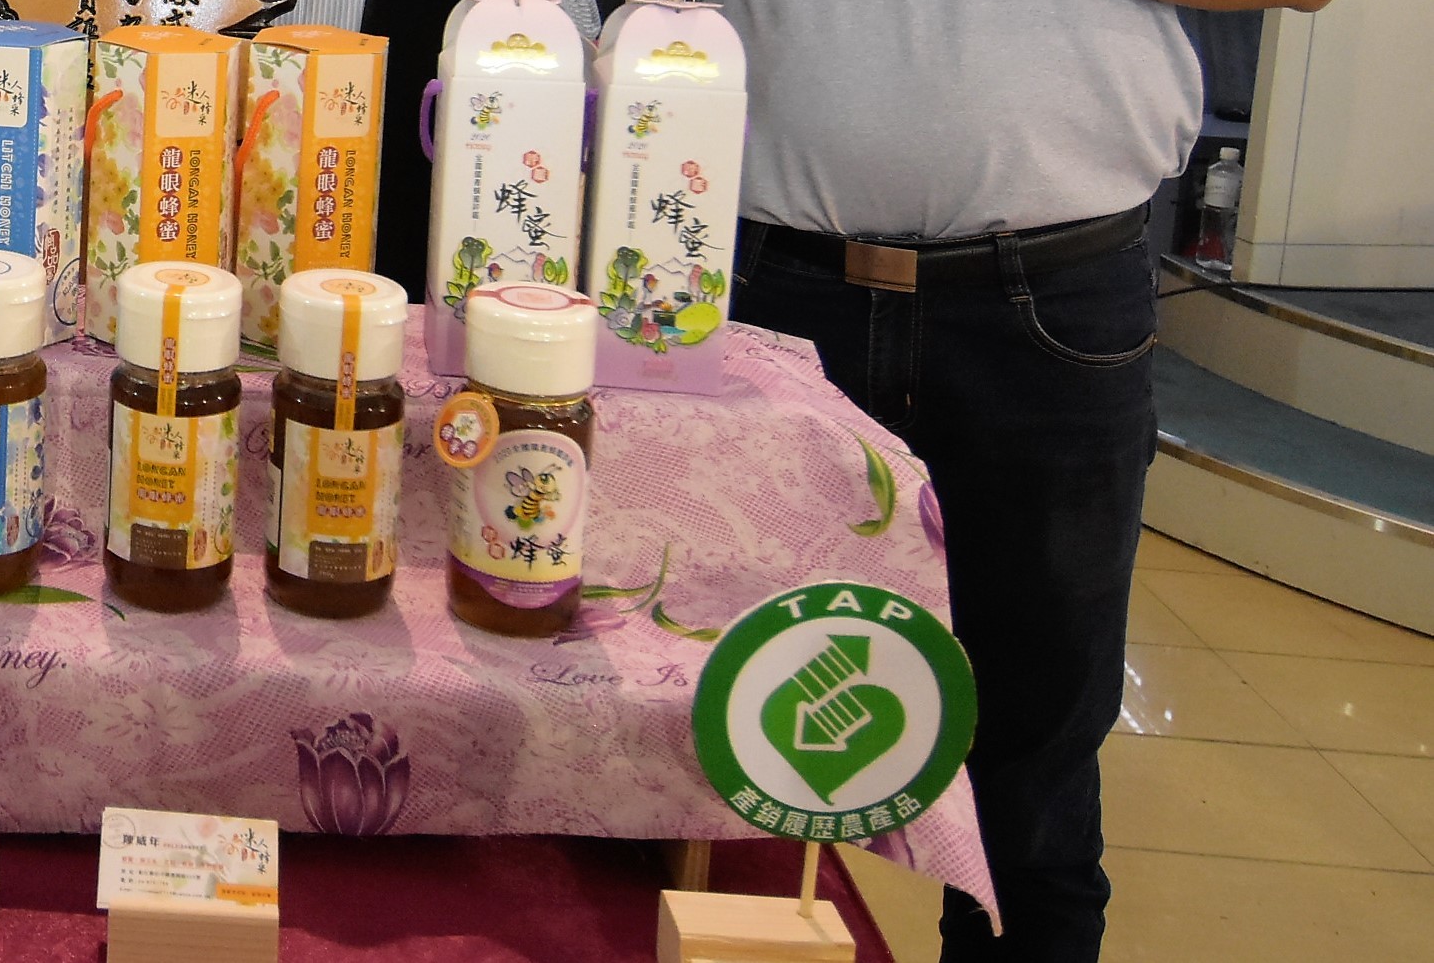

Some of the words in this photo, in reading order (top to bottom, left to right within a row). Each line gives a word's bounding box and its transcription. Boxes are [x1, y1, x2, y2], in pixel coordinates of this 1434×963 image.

[0, 140, 14, 190] LITCHI
[188, 150, 201, 208] LONGAN
[342, 150, 356, 208] LONGAN
[158, 146, 183, 242] 龍眼蜂蜜
[314, 146, 339, 242] 龍眼蜂蜜
[494, 179, 567, 250] 蜂蜜
[186, 213, 198, 259] HONEY
[340, 213, 353, 258] HONEY
[651, 190, 725, 262] 蜂蜜
[137, 461, 186, 476] LONGAN
[137, 475, 175, 489] HONEY
[316, 478, 366, 490] LONGAN
[316, 492, 356, 503] HONEY
[510, 534, 574, 569] 蜂蜜
[777, 590, 914, 621] TAP
[525, 661, 624, 686] Love
[636, 663, 688, 686] Is
[729, 785, 922, 839] 產銷履歷農產品
